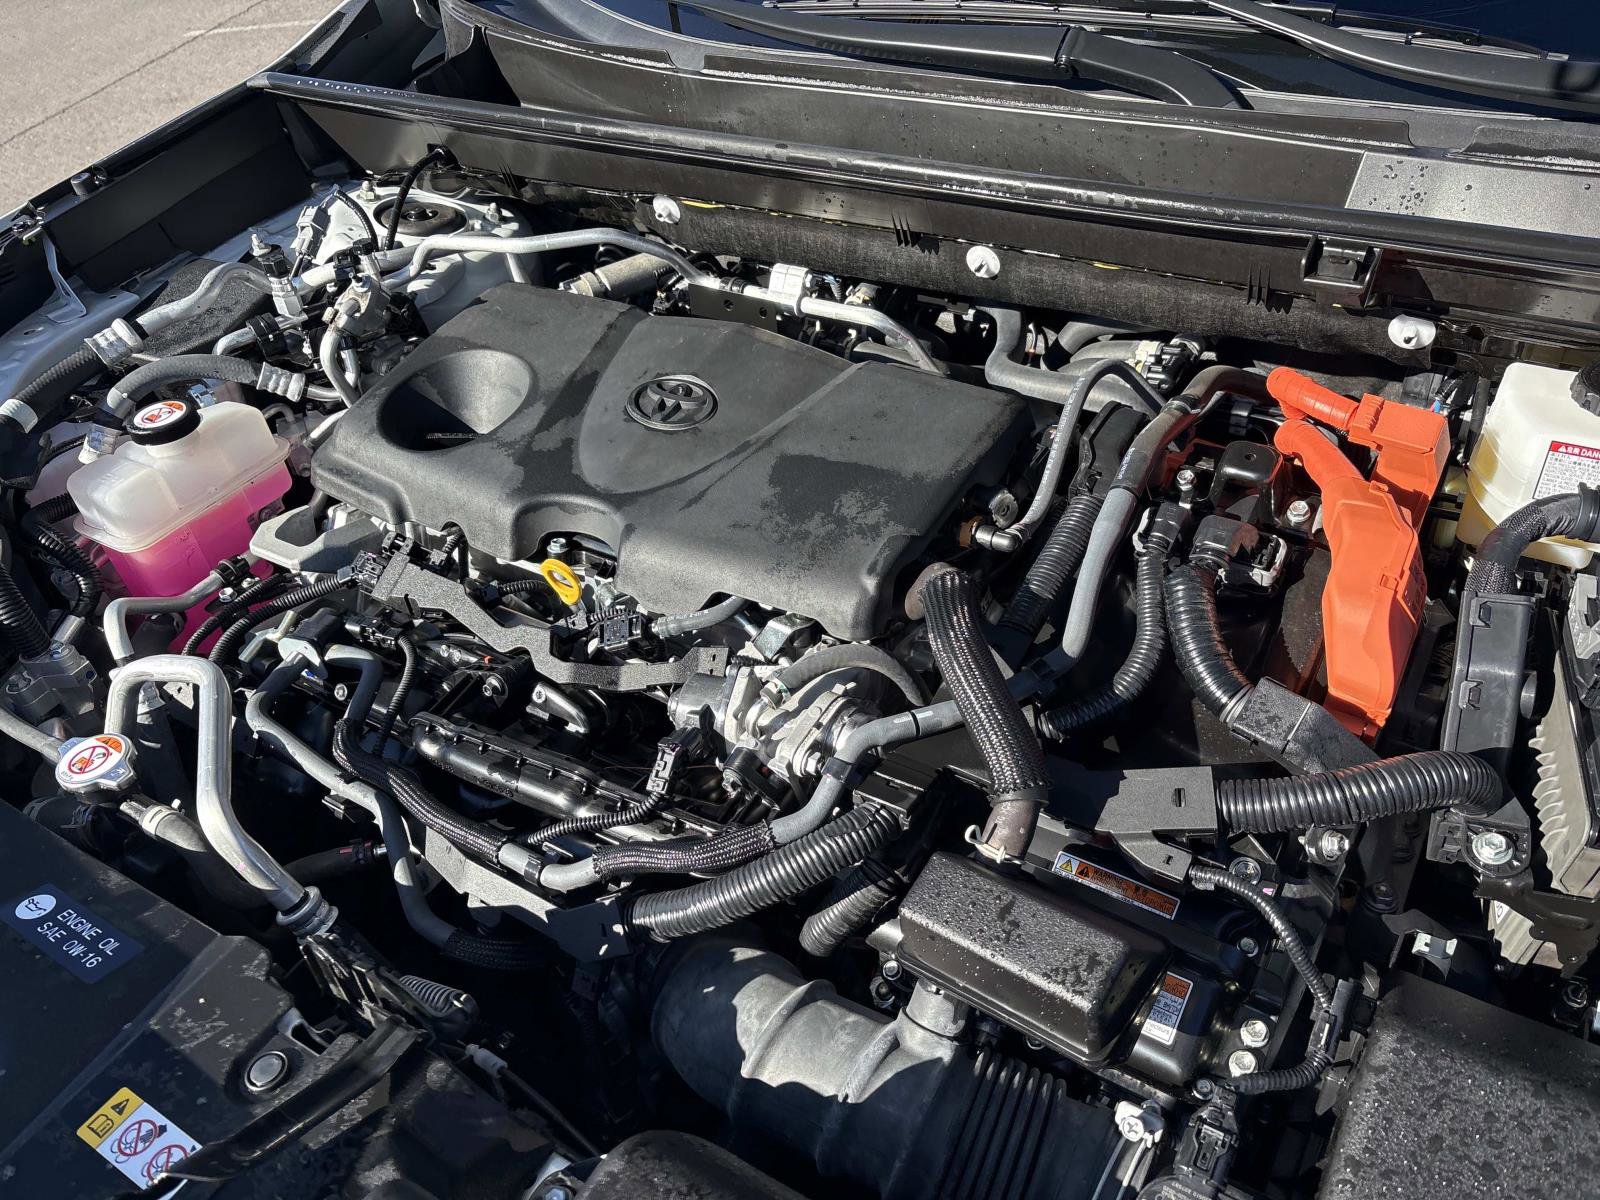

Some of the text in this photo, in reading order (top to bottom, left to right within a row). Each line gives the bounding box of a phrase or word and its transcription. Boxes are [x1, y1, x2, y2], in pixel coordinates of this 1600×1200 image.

[1581, 448, 1600, 459] DAN
[37, 922, 102, 968] SAE 0W-16
[57, 909, 120, 956] ENGINE OIL
